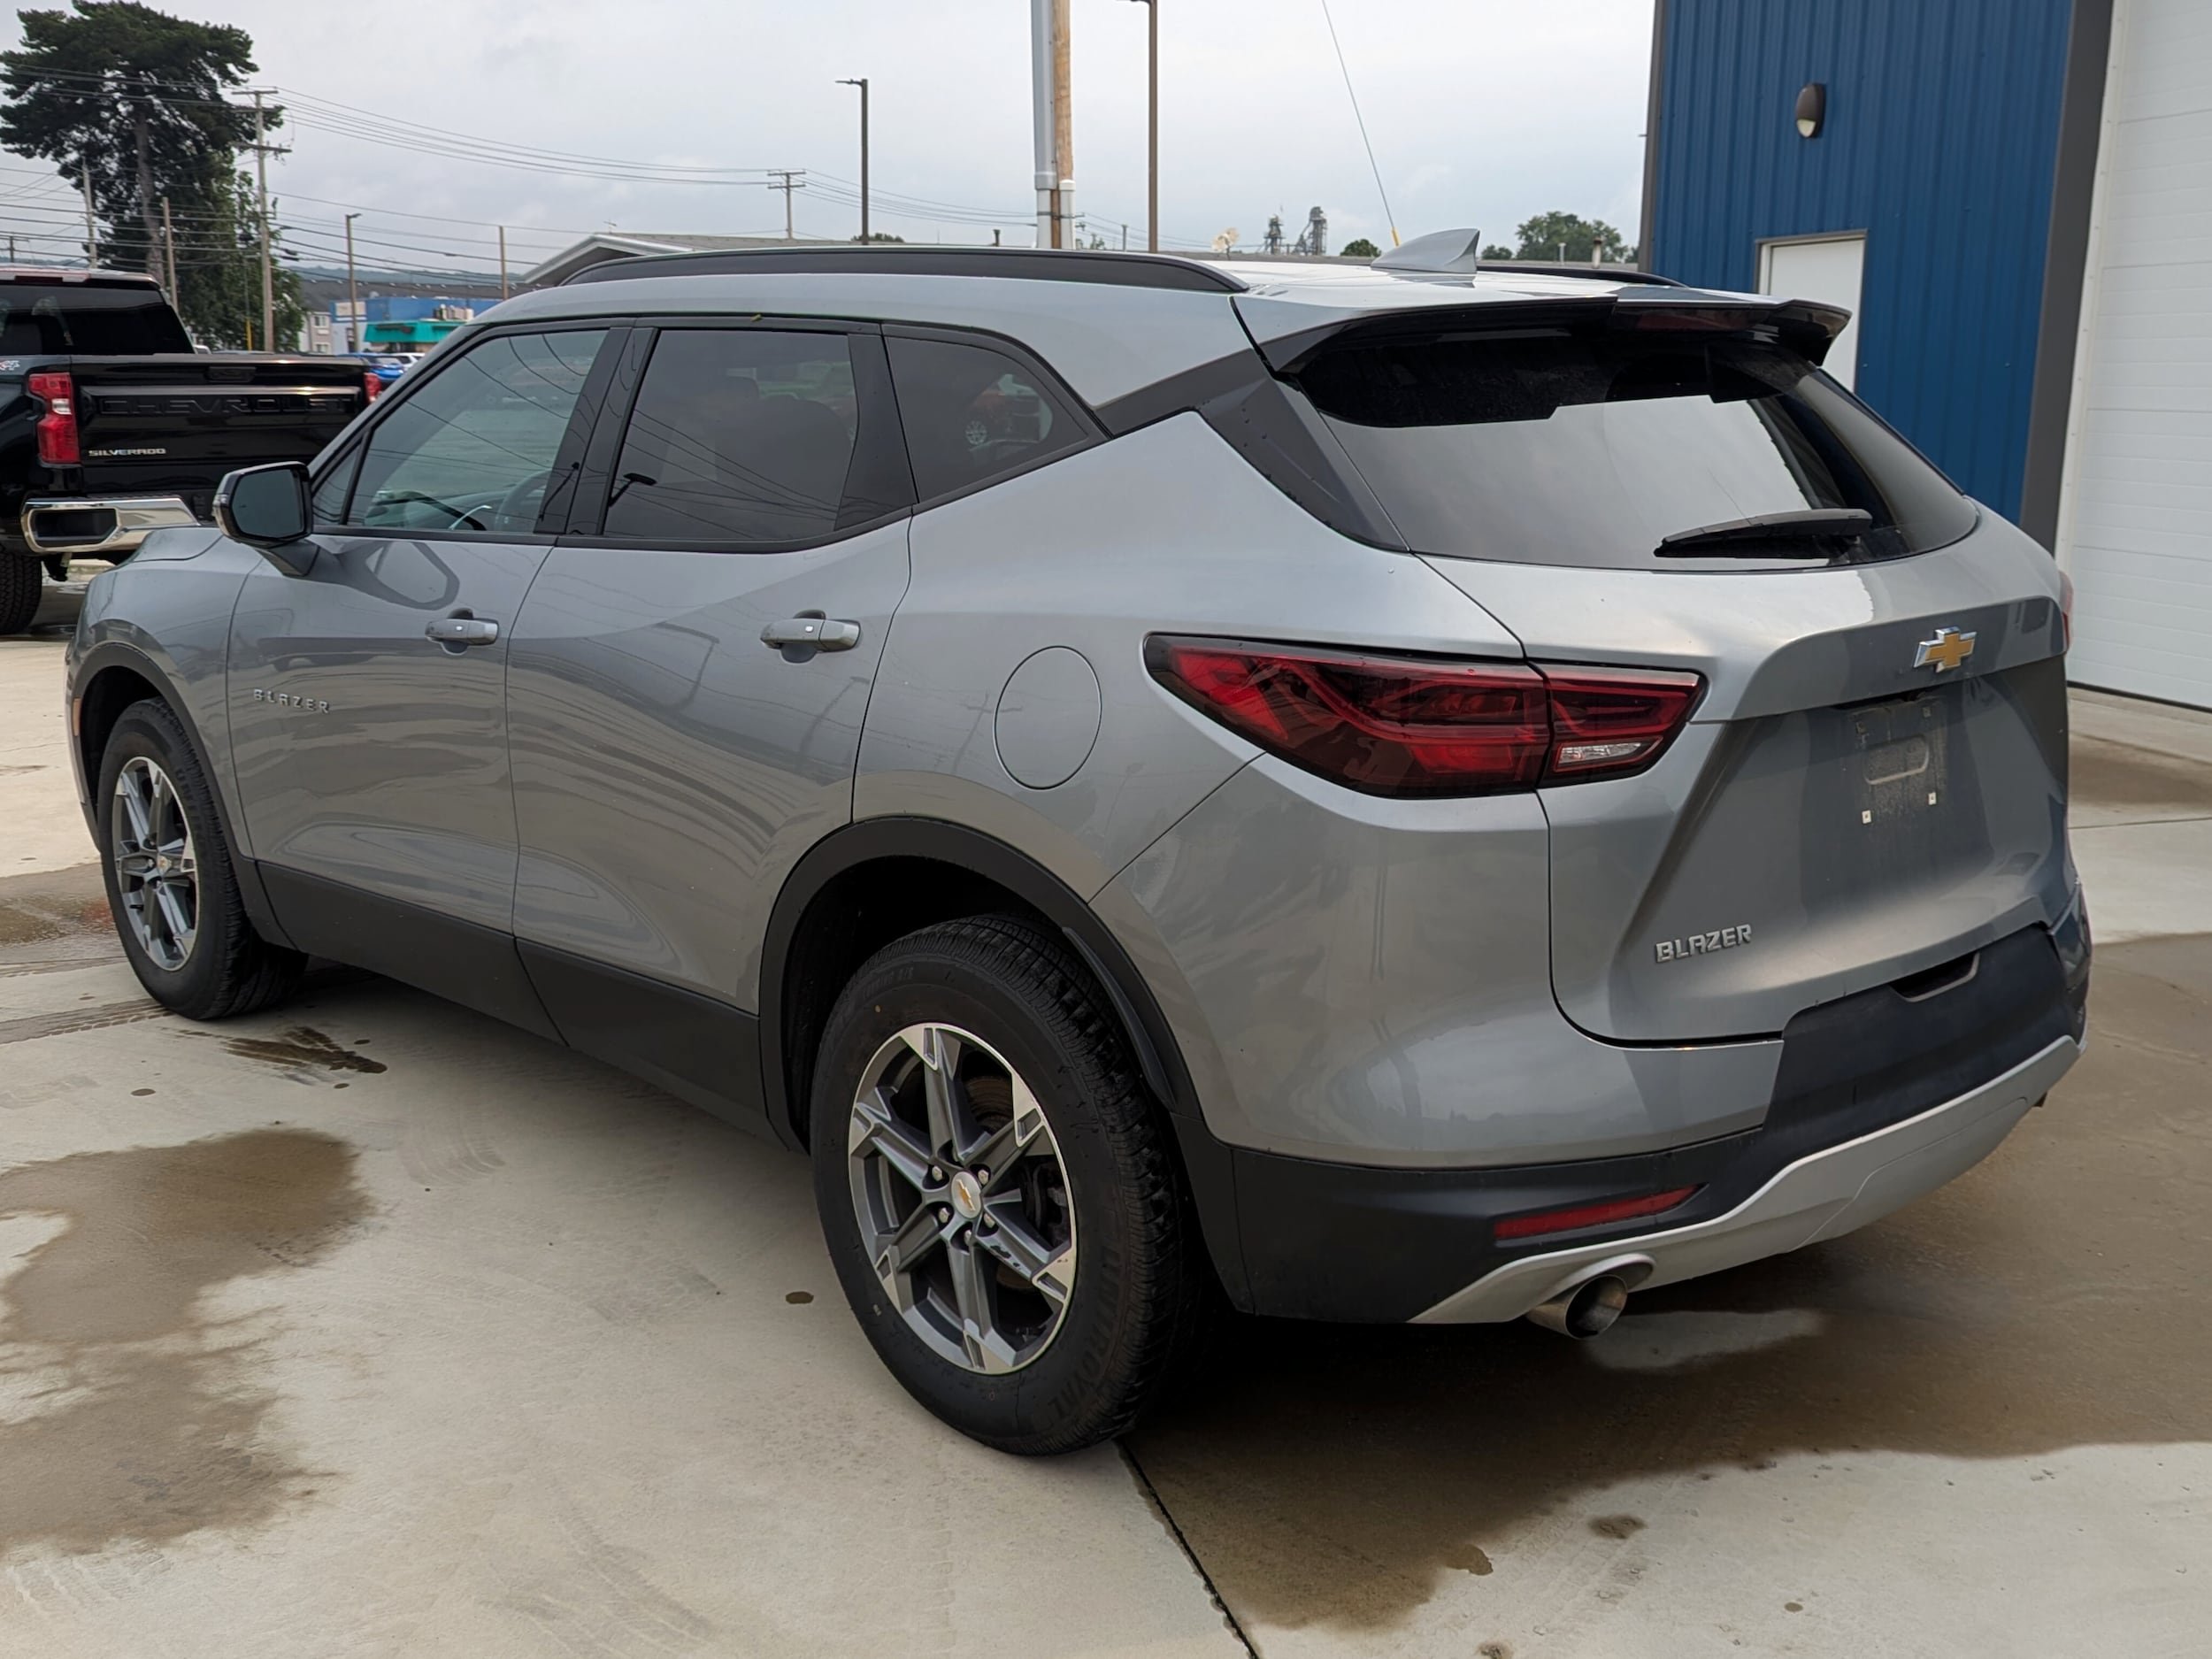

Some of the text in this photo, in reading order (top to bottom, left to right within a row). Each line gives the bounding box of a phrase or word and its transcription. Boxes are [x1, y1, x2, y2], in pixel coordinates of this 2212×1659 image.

[88, 448, 166, 457] SILVERADO
[253, 688, 330, 714] BLAZER
[1655, 924, 1752, 963] BLAZER
